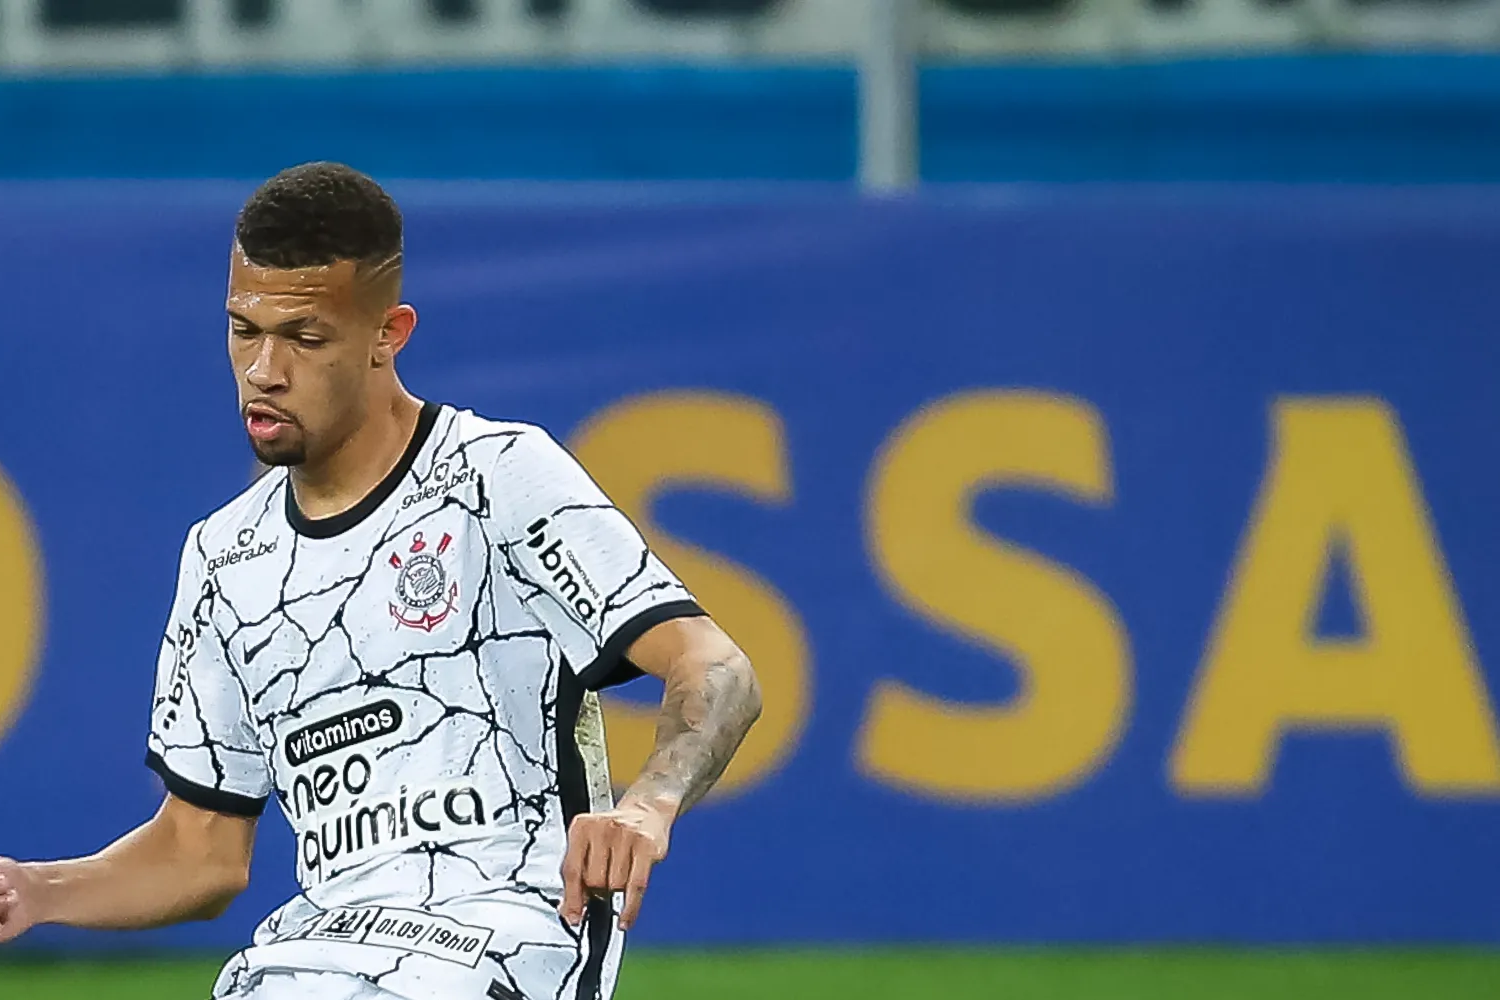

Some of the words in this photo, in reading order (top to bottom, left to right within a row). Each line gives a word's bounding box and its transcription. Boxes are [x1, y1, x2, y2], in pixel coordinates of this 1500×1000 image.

[290, 707, 395, 760] vitaminas
[292, 753, 372, 820] neo
[302, 784, 487, 884] química
